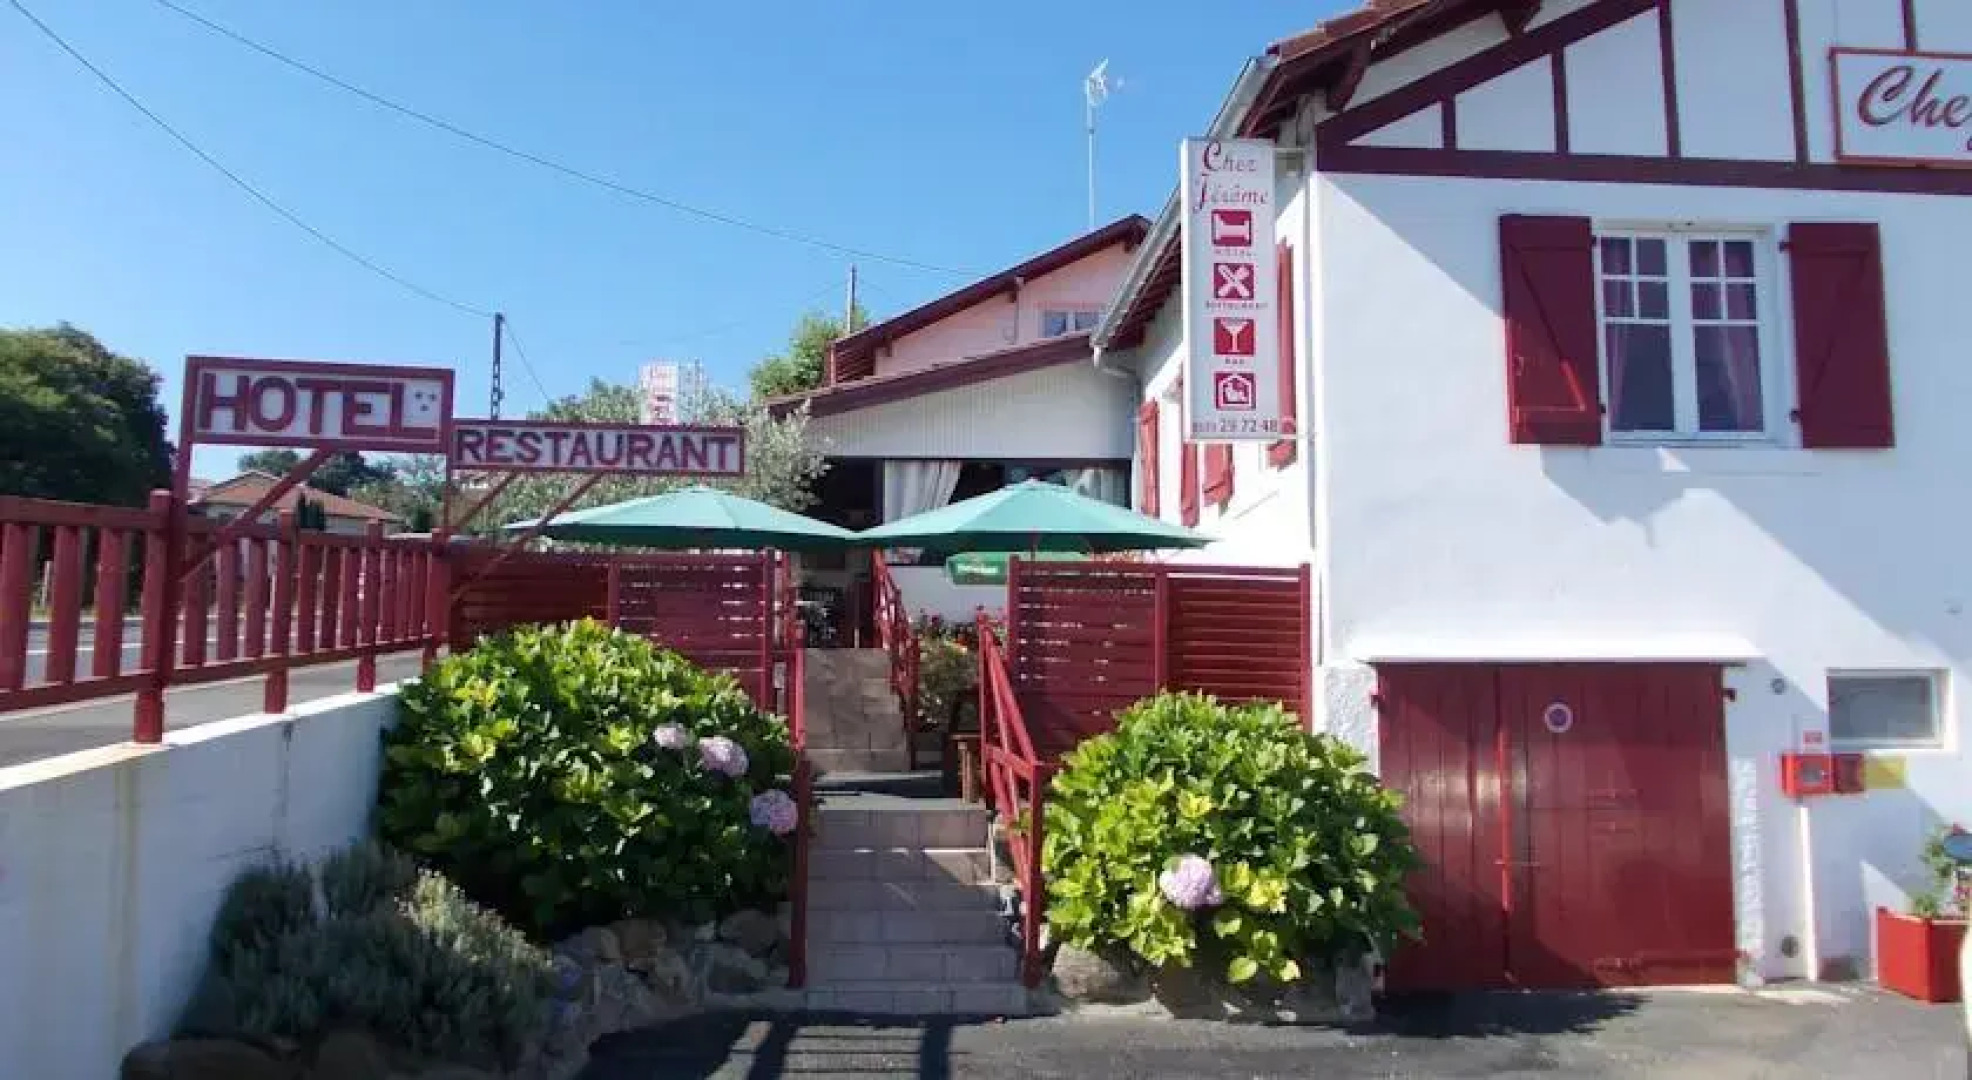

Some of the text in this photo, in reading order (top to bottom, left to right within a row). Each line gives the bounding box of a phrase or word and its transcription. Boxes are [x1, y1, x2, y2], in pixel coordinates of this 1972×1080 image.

[1857, 65, 1972, 151] Che
[1202, 139, 1257, 172] Chez
[197, 371, 438, 437] HOTEL
[456, 428, 736, 470] RESTAURANT
